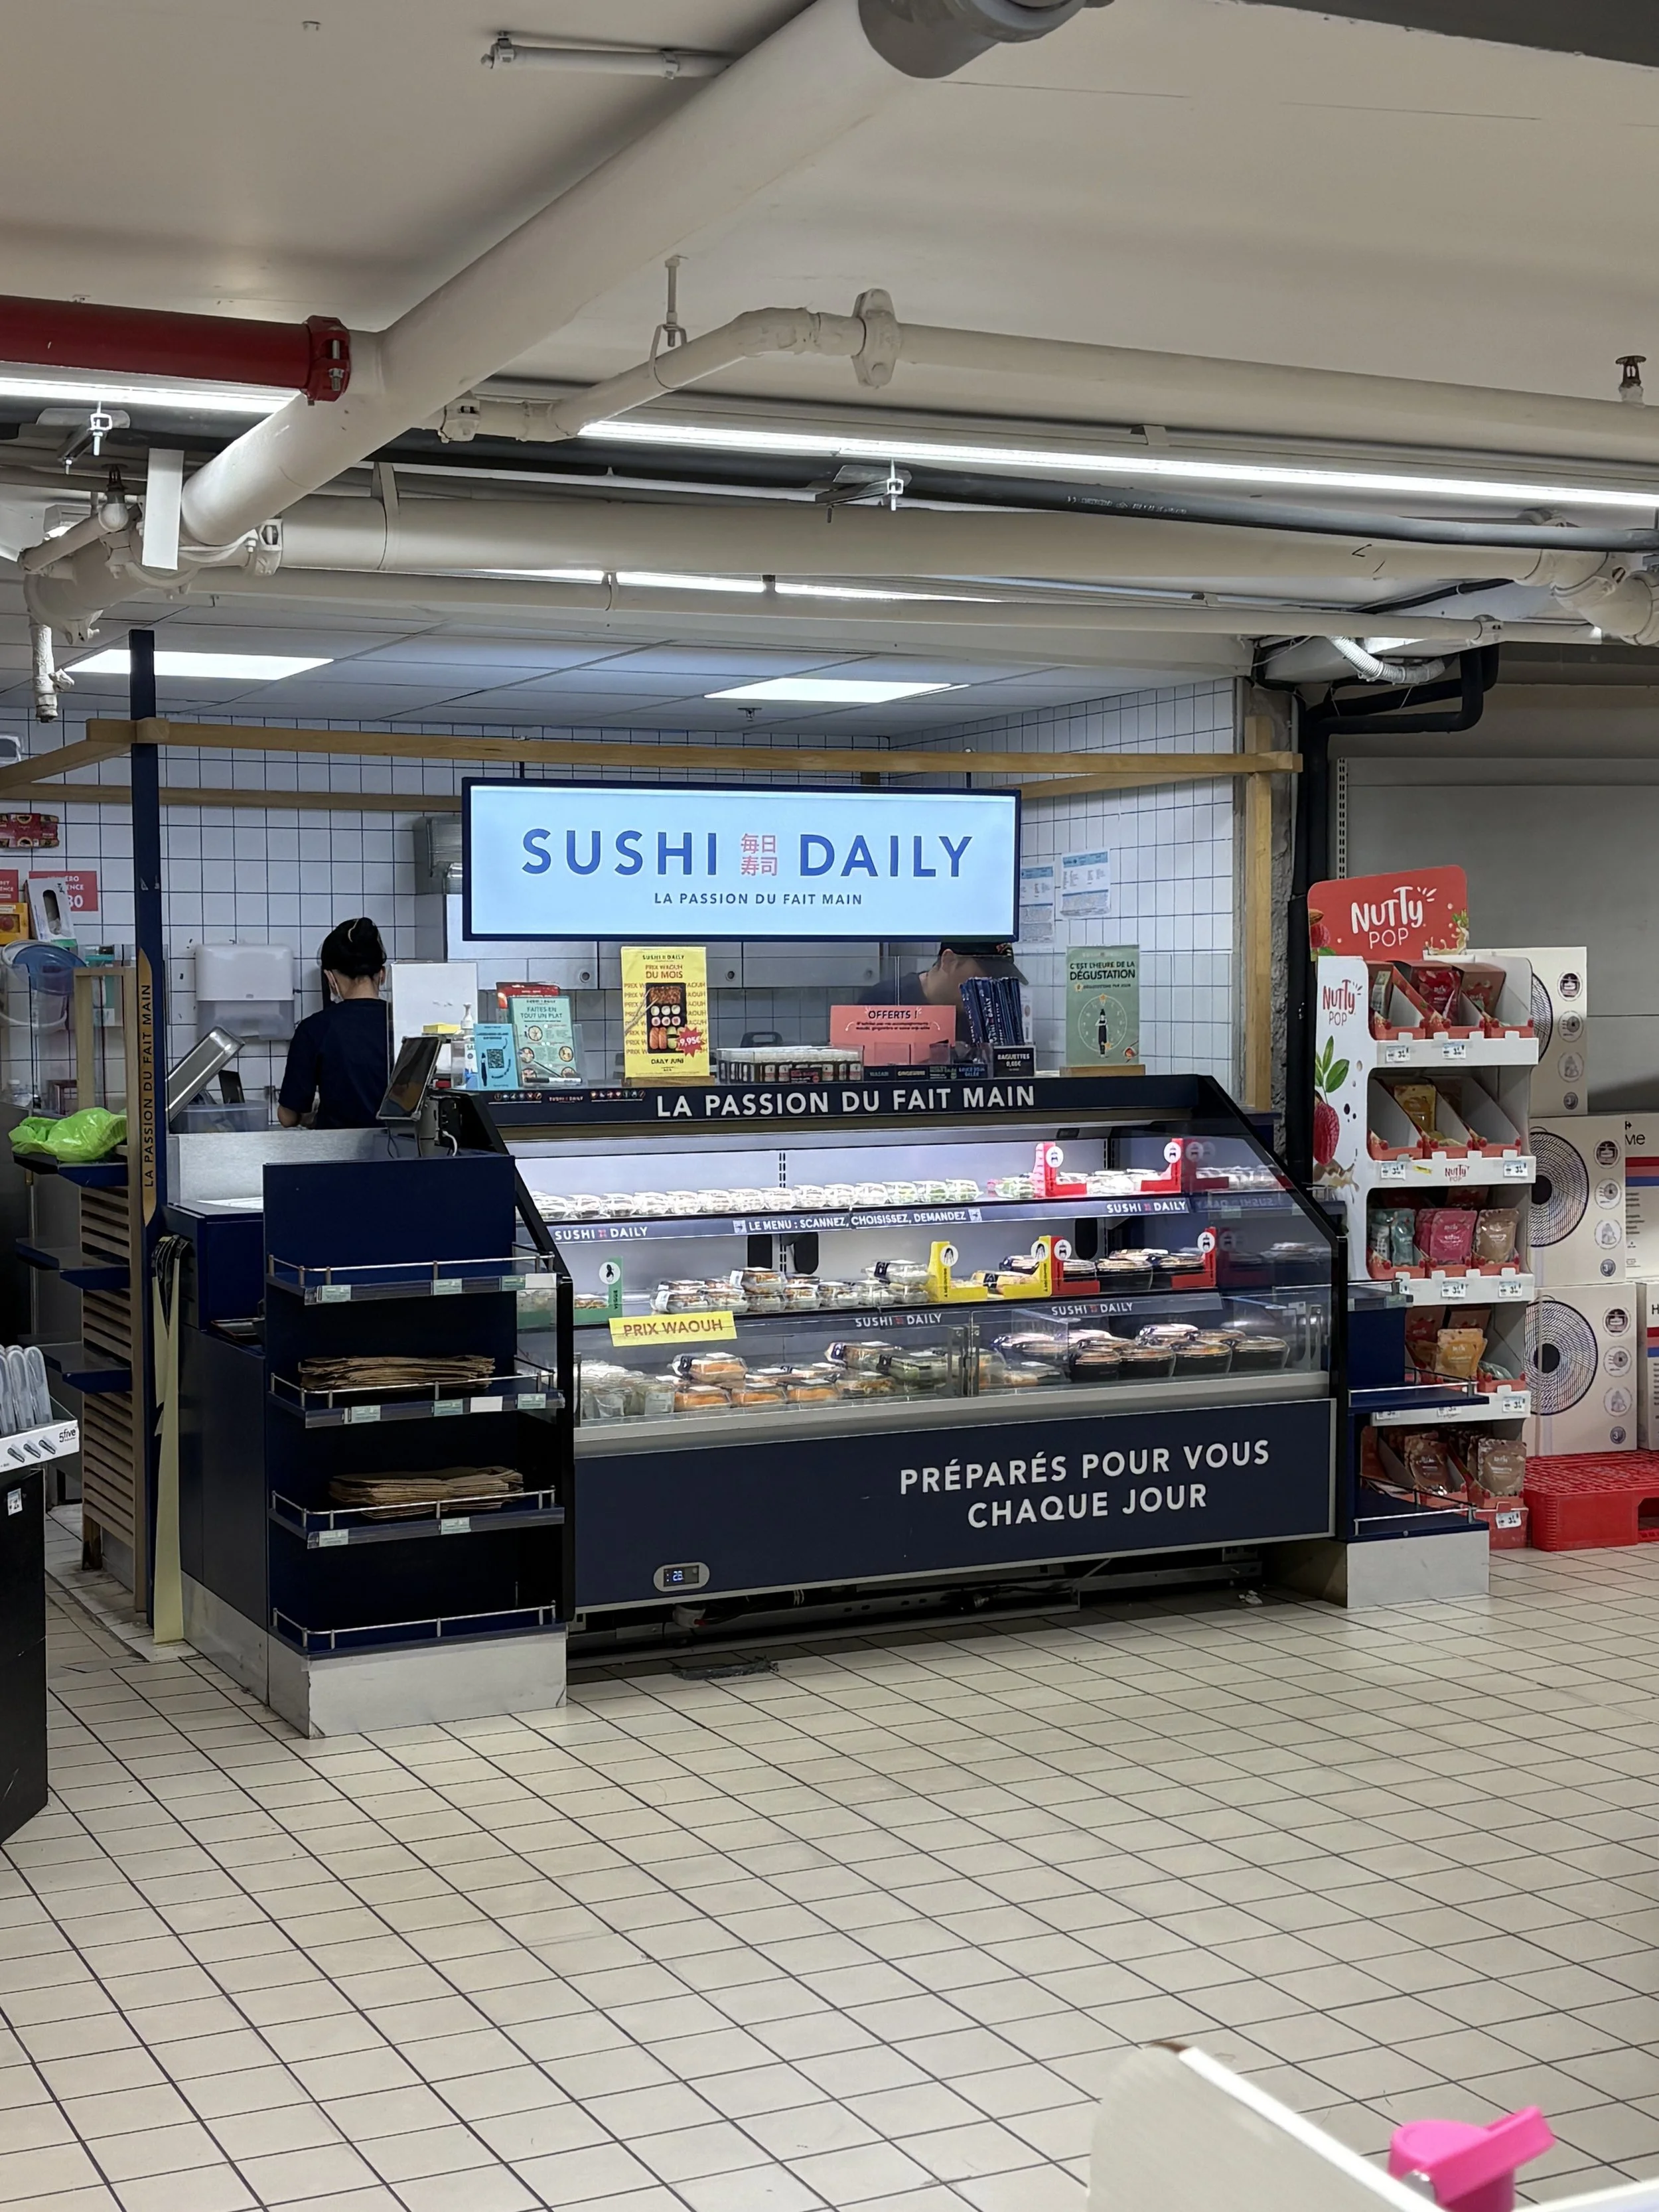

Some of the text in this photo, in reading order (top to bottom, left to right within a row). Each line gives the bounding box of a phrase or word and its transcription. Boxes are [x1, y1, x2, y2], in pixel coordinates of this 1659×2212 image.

[522, 828, 973, 877] SUSHI DAILY
[741, 833, 776, 854] 毎日
[741, 855, 778, 876] 寿司
[654, 893, 862, 905] LA PASSION DU FAIT MAIN
[1369, 927, 1409, 950] POP
[1070, 968, 1135, 980] DÉGUSTATION
[868, 1010, 911, 1019] OFFERTS
[1329, 1011, 1347, 1027] POP
[141, 985, 153, 1187] LA PASSION DU FAIT MAIN
[657, 1086, 1034, 1117] LA PASSION DU FAIT MAIN
[1107, 1201, 1186, 1214] SUSHI DAILY
[749, 1221, 761, 1231] LE
[762, 1220, 792, 1230] MENU
[800, 1216, 850, 1229] SCANNEZ,
[851, 1213, 912, 1226] CHOISISSEZ,
[913, 1211, 967, 1222] DEMANDEZ
[555, 1229, 595, 1240] SUSHI
[610, 1226, 648, 1238] DAILY
[1051, 1302, 1133, 1315] SUSHI DAILY
[624, 1319, 723, 1337] PRIX WAOUH
[855, 1313, 942, 1327] SUSHI DAILY
[900, 1439, 1269, 1495] PRÉPARÉS POUR VOUS
[968, 1484, 1207, 1528] CHAQUE JOUR
